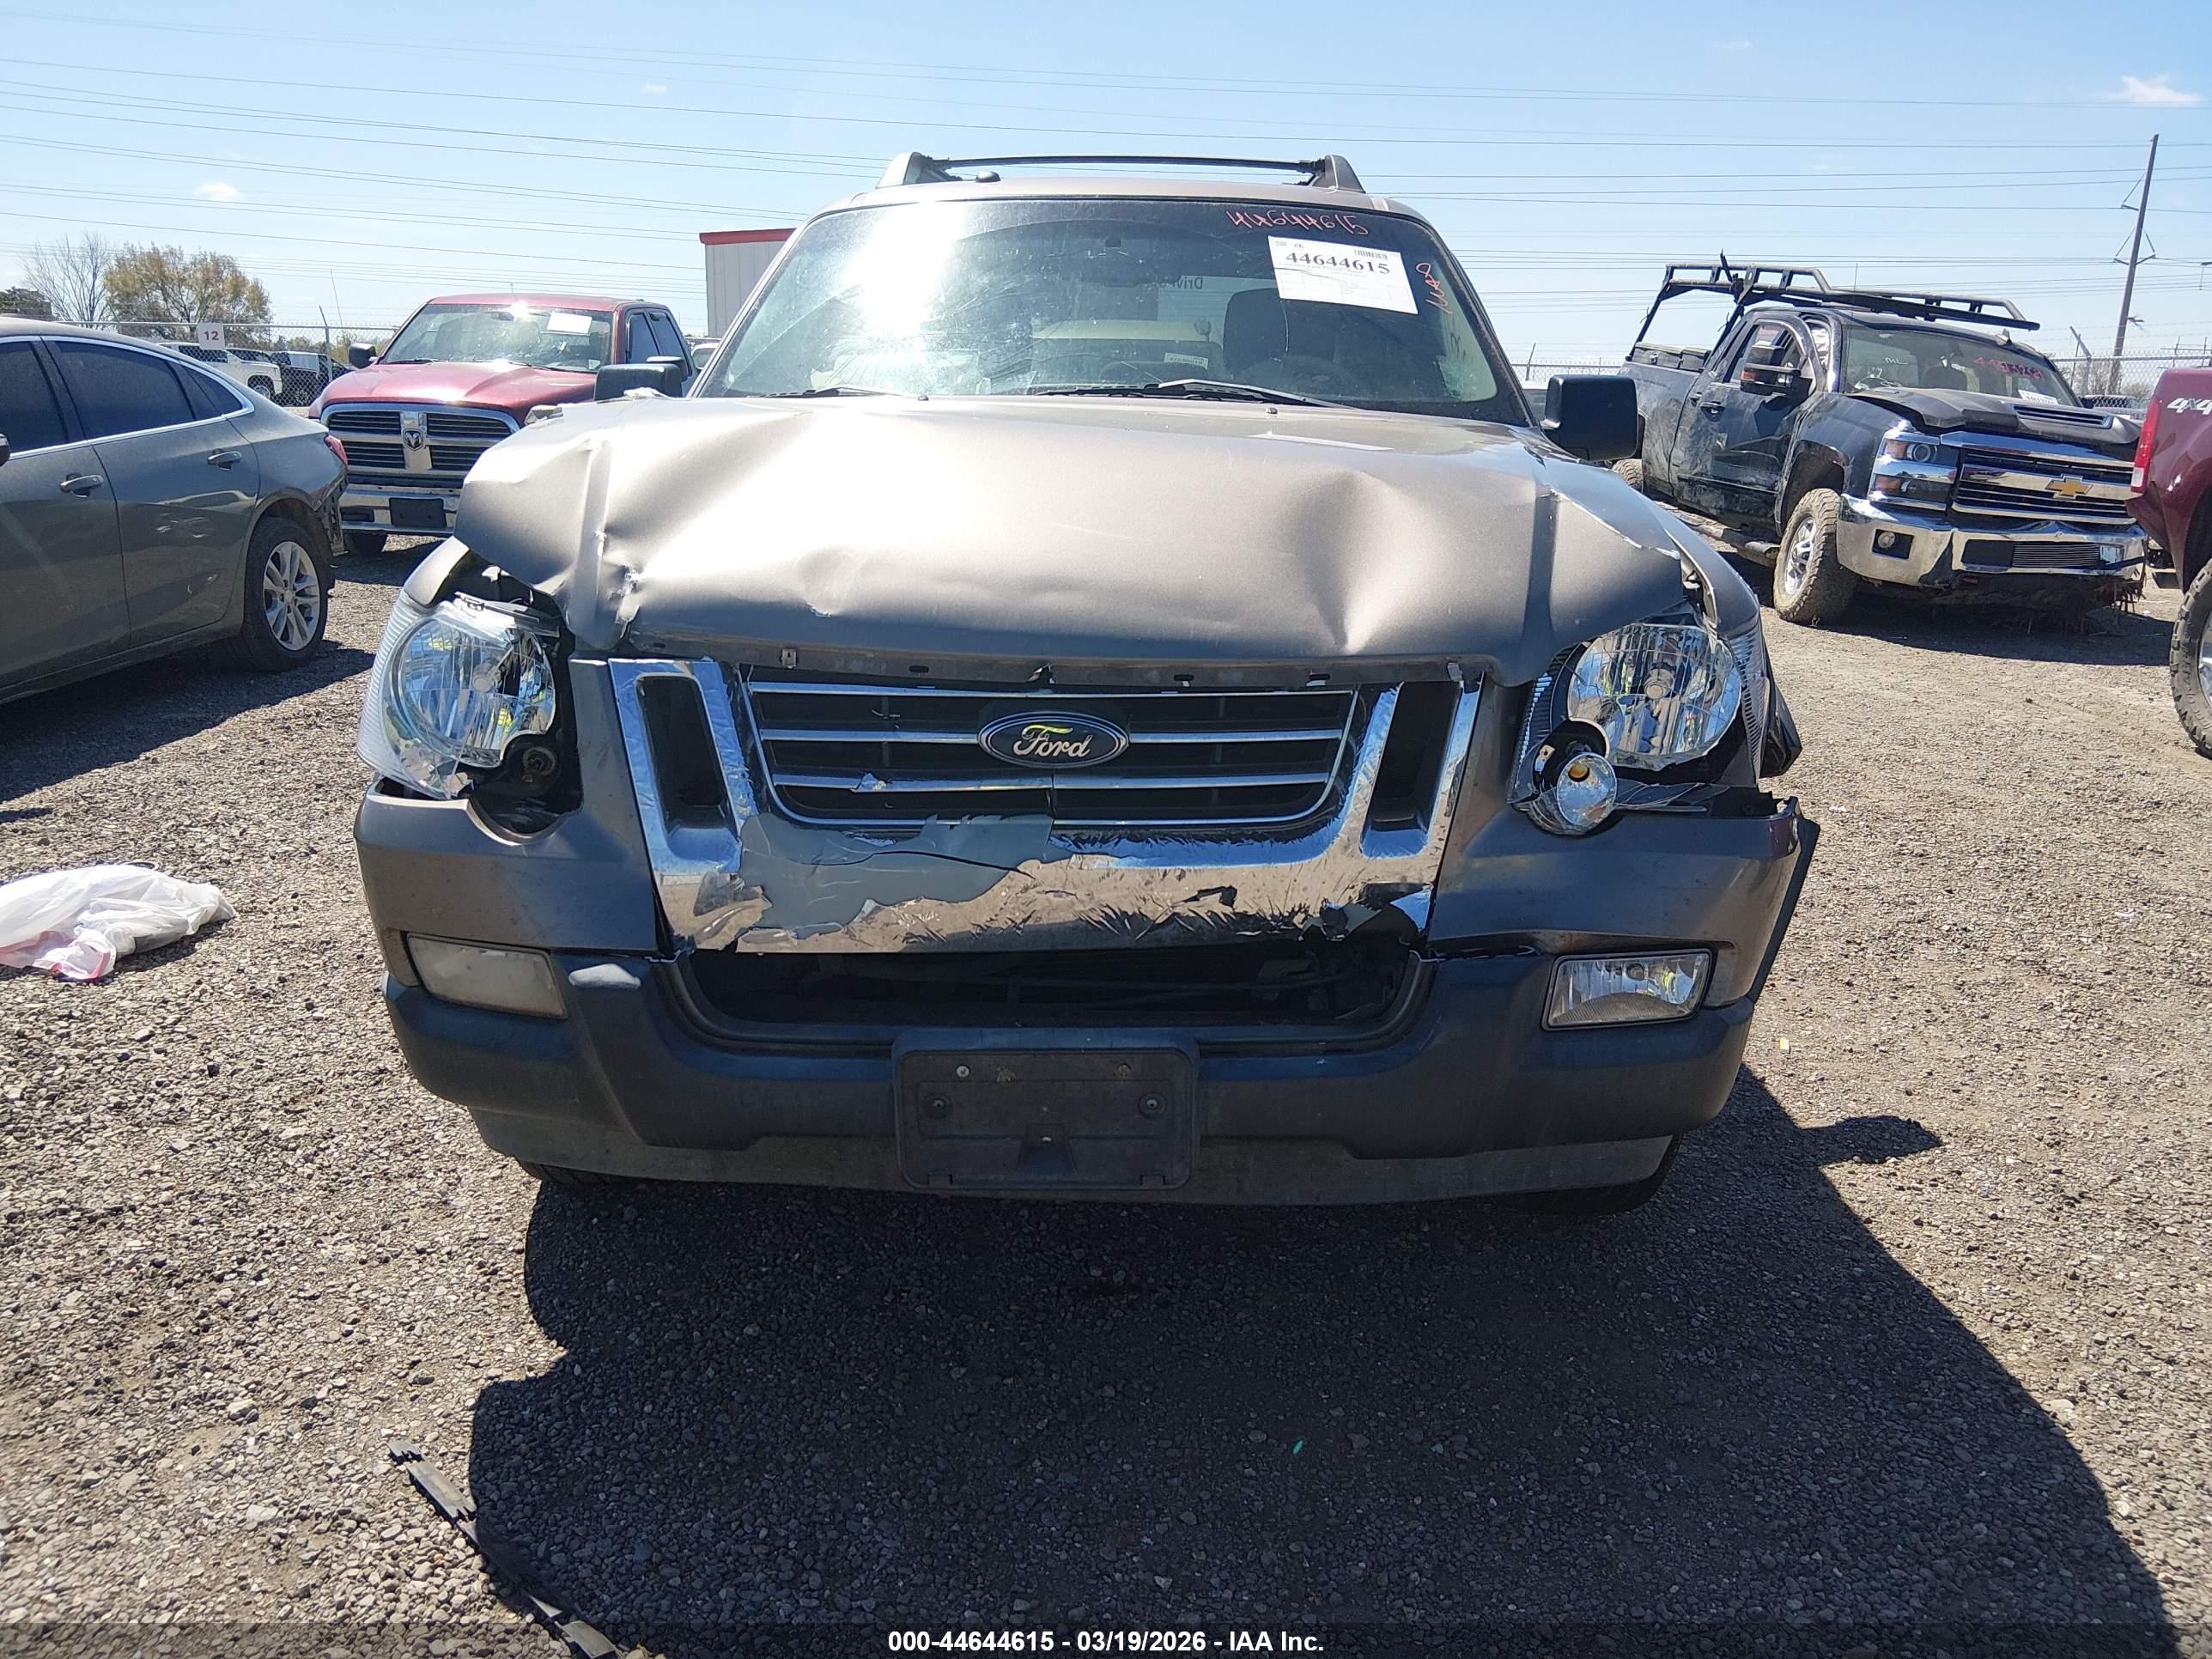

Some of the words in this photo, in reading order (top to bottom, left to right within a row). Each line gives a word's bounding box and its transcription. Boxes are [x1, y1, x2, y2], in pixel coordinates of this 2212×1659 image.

[1286, 252, 1390, 275] 44644615
[204, 331, 220, 341] 12
[1013, 725, 1093, 757] Ford
